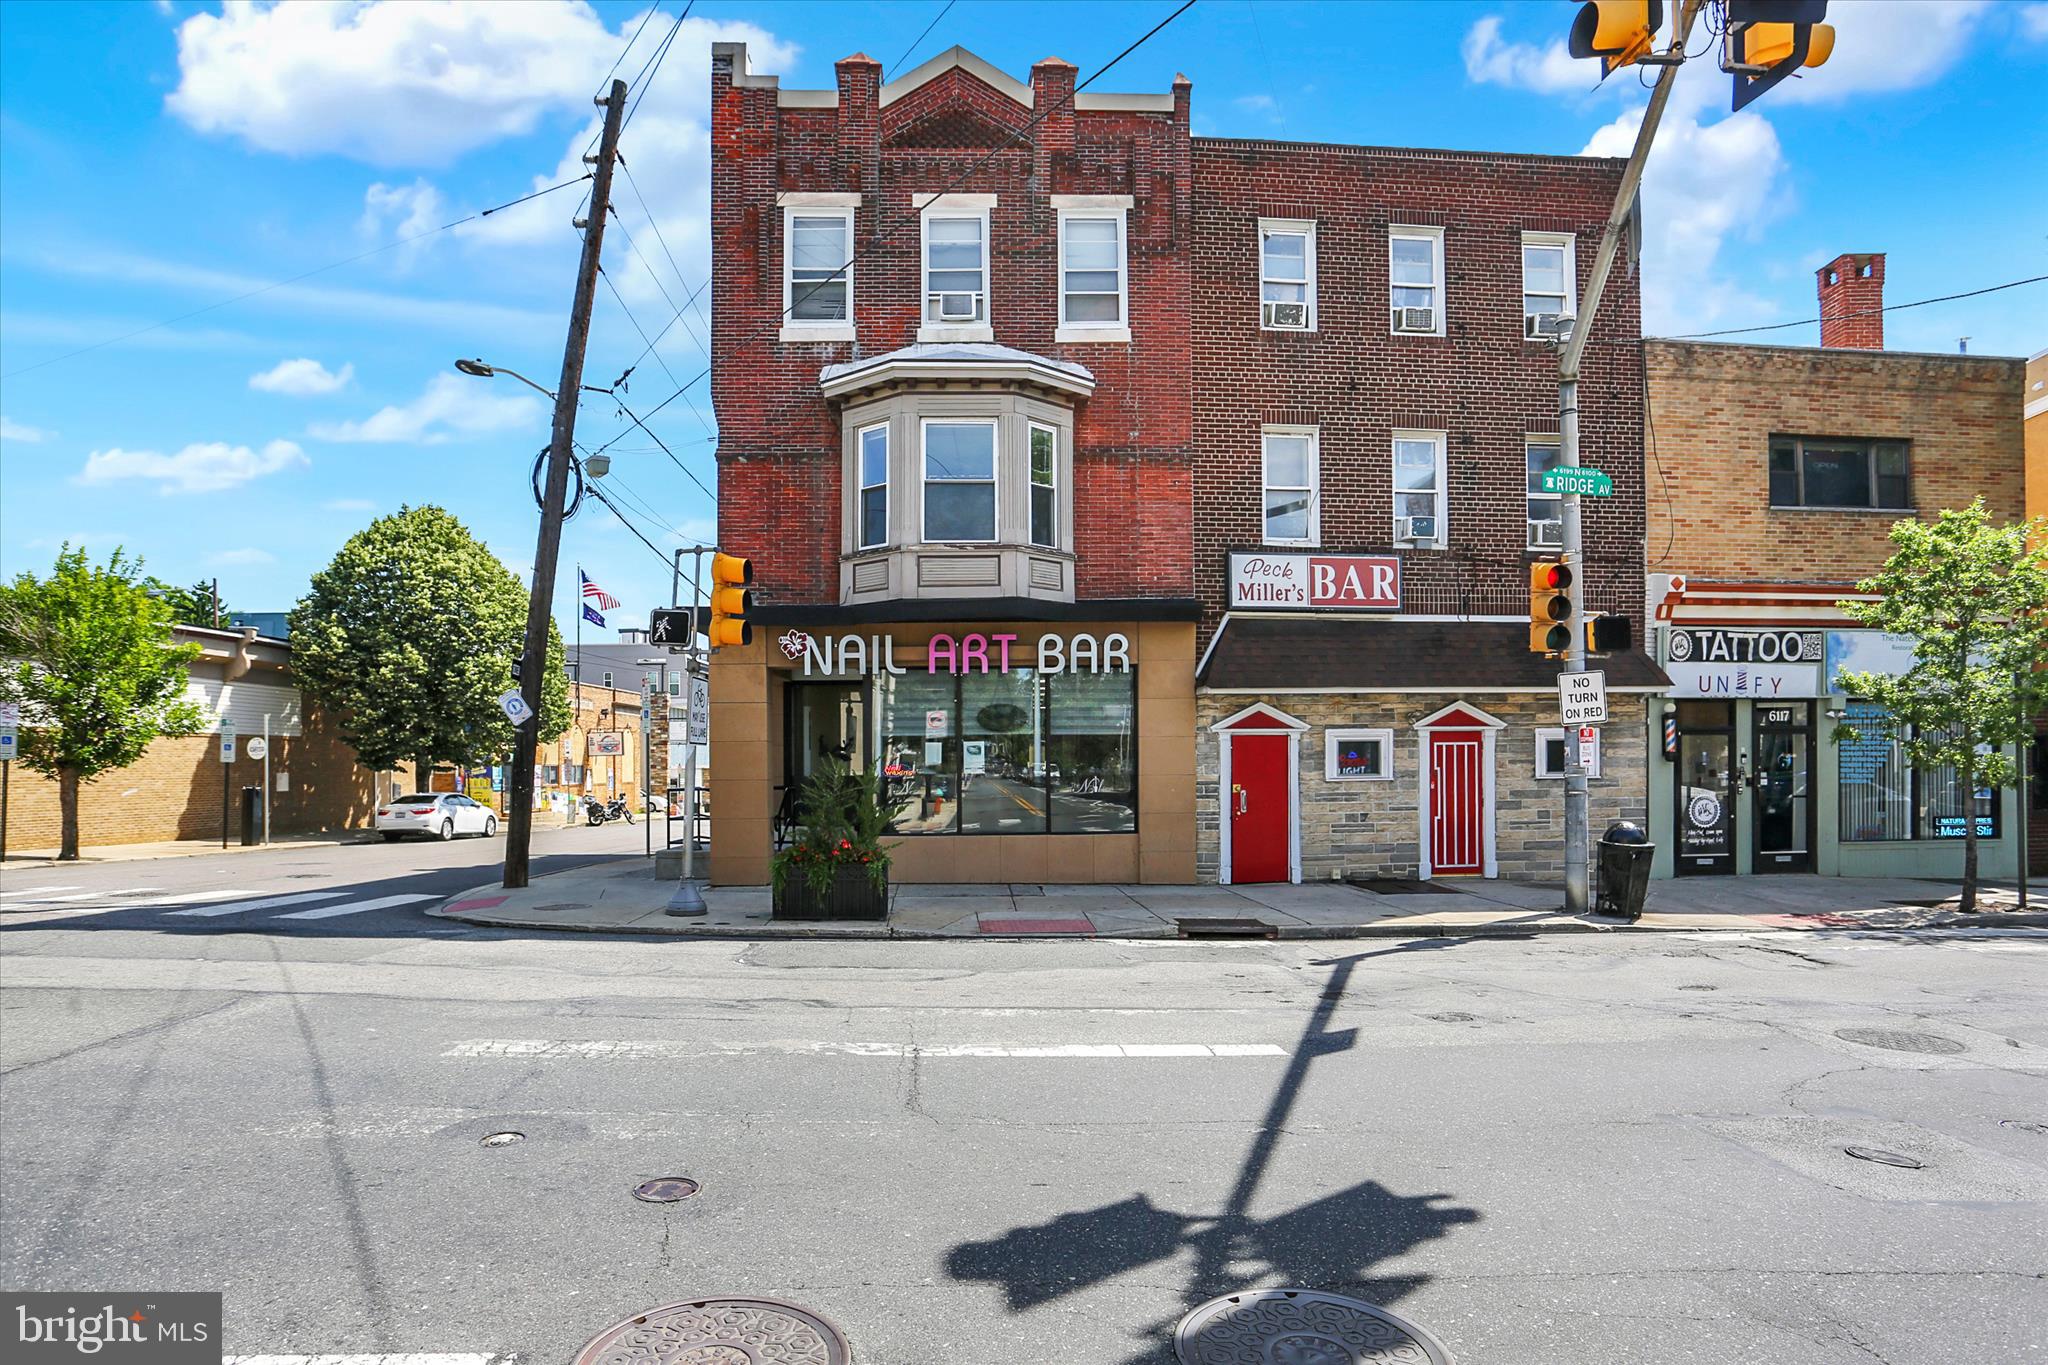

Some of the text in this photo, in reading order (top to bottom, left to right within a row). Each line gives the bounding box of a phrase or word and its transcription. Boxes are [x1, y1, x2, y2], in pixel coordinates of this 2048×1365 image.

[1557, 476, 1610, 495] RIDGE AV
[1243, 558, 1294, 580] Peck
[1311, 564, 1398, 600] BAR
[1238, 582, 1304, 602] Miller's
[1881, 634, 1895, 642] The
[803, 633, 1130, 676] NAIL ART BAR
[1695, 631, 1803, 662] TATTOO
[1573, 678, 1590, 689] NO
[1568, 692, 1598, 703] TURN
[1565, 706, 1603, 719] ON RED
[1768, 710, 1790, 722] 6117
[1940, 827, 1967, 836] Musc
